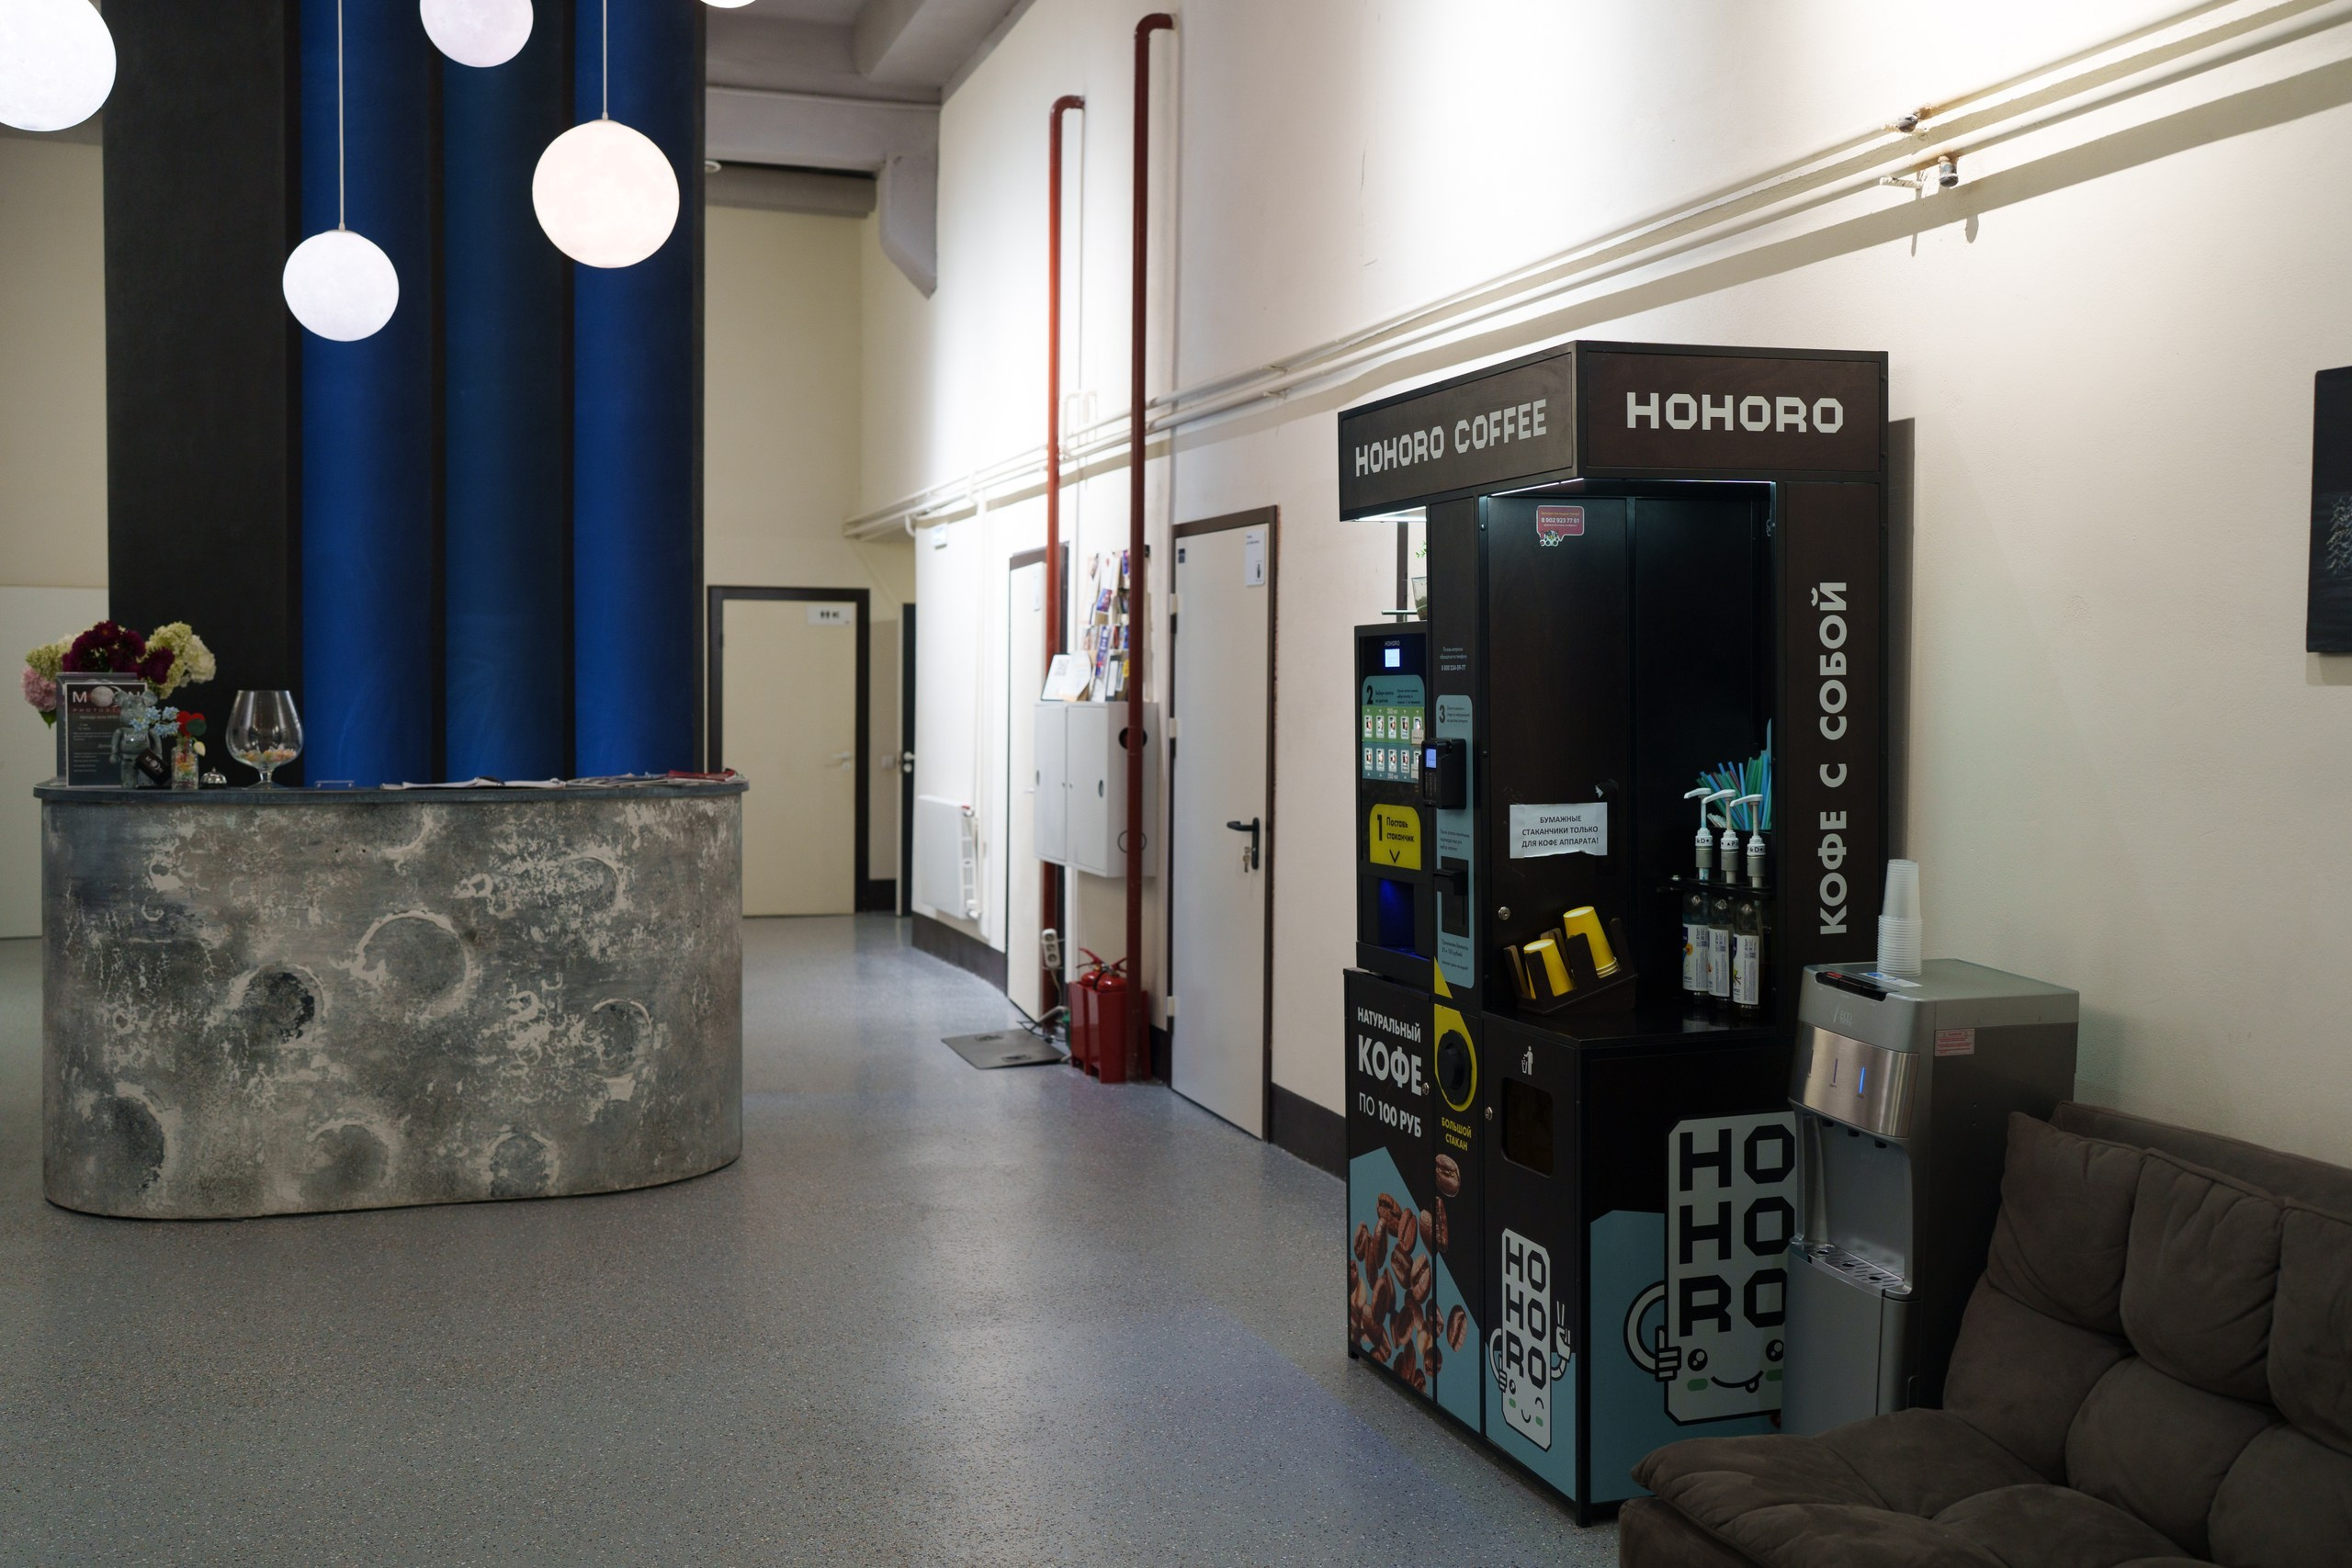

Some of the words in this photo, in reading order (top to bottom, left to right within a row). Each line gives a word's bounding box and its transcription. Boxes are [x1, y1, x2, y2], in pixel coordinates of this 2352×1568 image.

[1627, 392, 1843, 434] HOHORO
[1356, 425, 1444, 477] HOHORO
[1454, 399, 1546, 454] COFFEE
[1811, 582, 1848, 740] СОБОЙ
[1366, 685, 1374, 705] 2
[1439, 705, 1445, 723] 3
[1819, 763, 1848, 788] С
[1377, 815, 1383, 841] 1
[1386, 817, 1408, 828] Поставь
[1386, 831, 1415, 842] стаканчик
[1521, 840, 1536, 849] ДЛЯ
[1559, 838, 1599, 846] АППАРАТА!
[1522, 827, 1568, 836] СТАКАНЧИКИ
[1818, 810, 1848, 934] КОФЕ
[1358, 1007, 1420, 1043] НАТУРАЛЬНЫЙ
[1358, 1034, 1421, 1096] КОФЕ
[1359, 1091, 1374, 1116] ПО
[1378, 1100, 1397, 1127] 100
[1400, 1110, 1421, 1137] РУБ
[1442, 1117, 1471, 1138] БОЛЬШОЙ
[1445, 1134, 1467, 1151] СТАКАН
[1679, 1124, 1795, 1191] HO
[1679, 1196, 1795, 1264] HO
[1506, 1235, 1546, 1293] HO
[1506, 1283, 1546, 1341] HO
[1679, 1268, 1788, 1337] RO
[1506, 1329, 1546, 1390] RO
